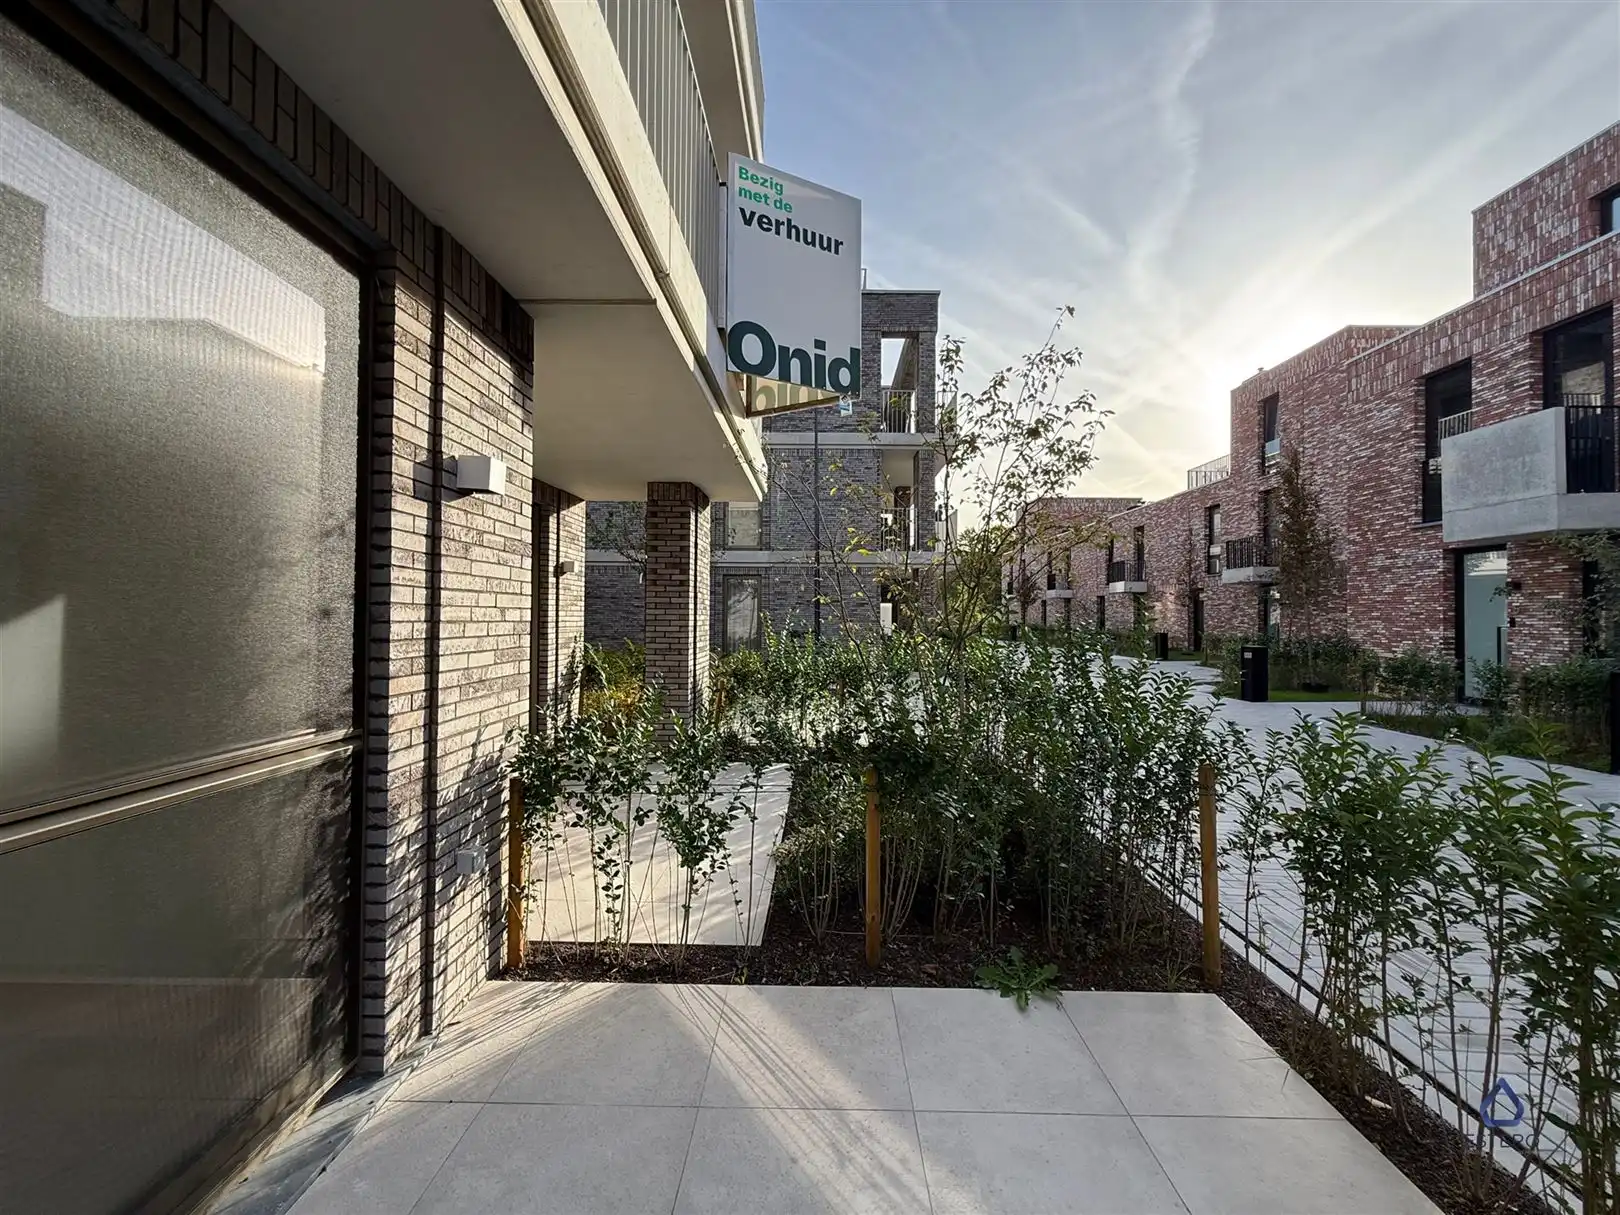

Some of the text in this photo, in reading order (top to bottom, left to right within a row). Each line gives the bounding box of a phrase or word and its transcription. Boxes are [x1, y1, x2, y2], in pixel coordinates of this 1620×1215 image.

[738, 165, 784, 196] Bezig
[738, 185, 793, 213] met de
[739, 206, 844, 256] verhuur
[728, 320, 861, 395] Onid
